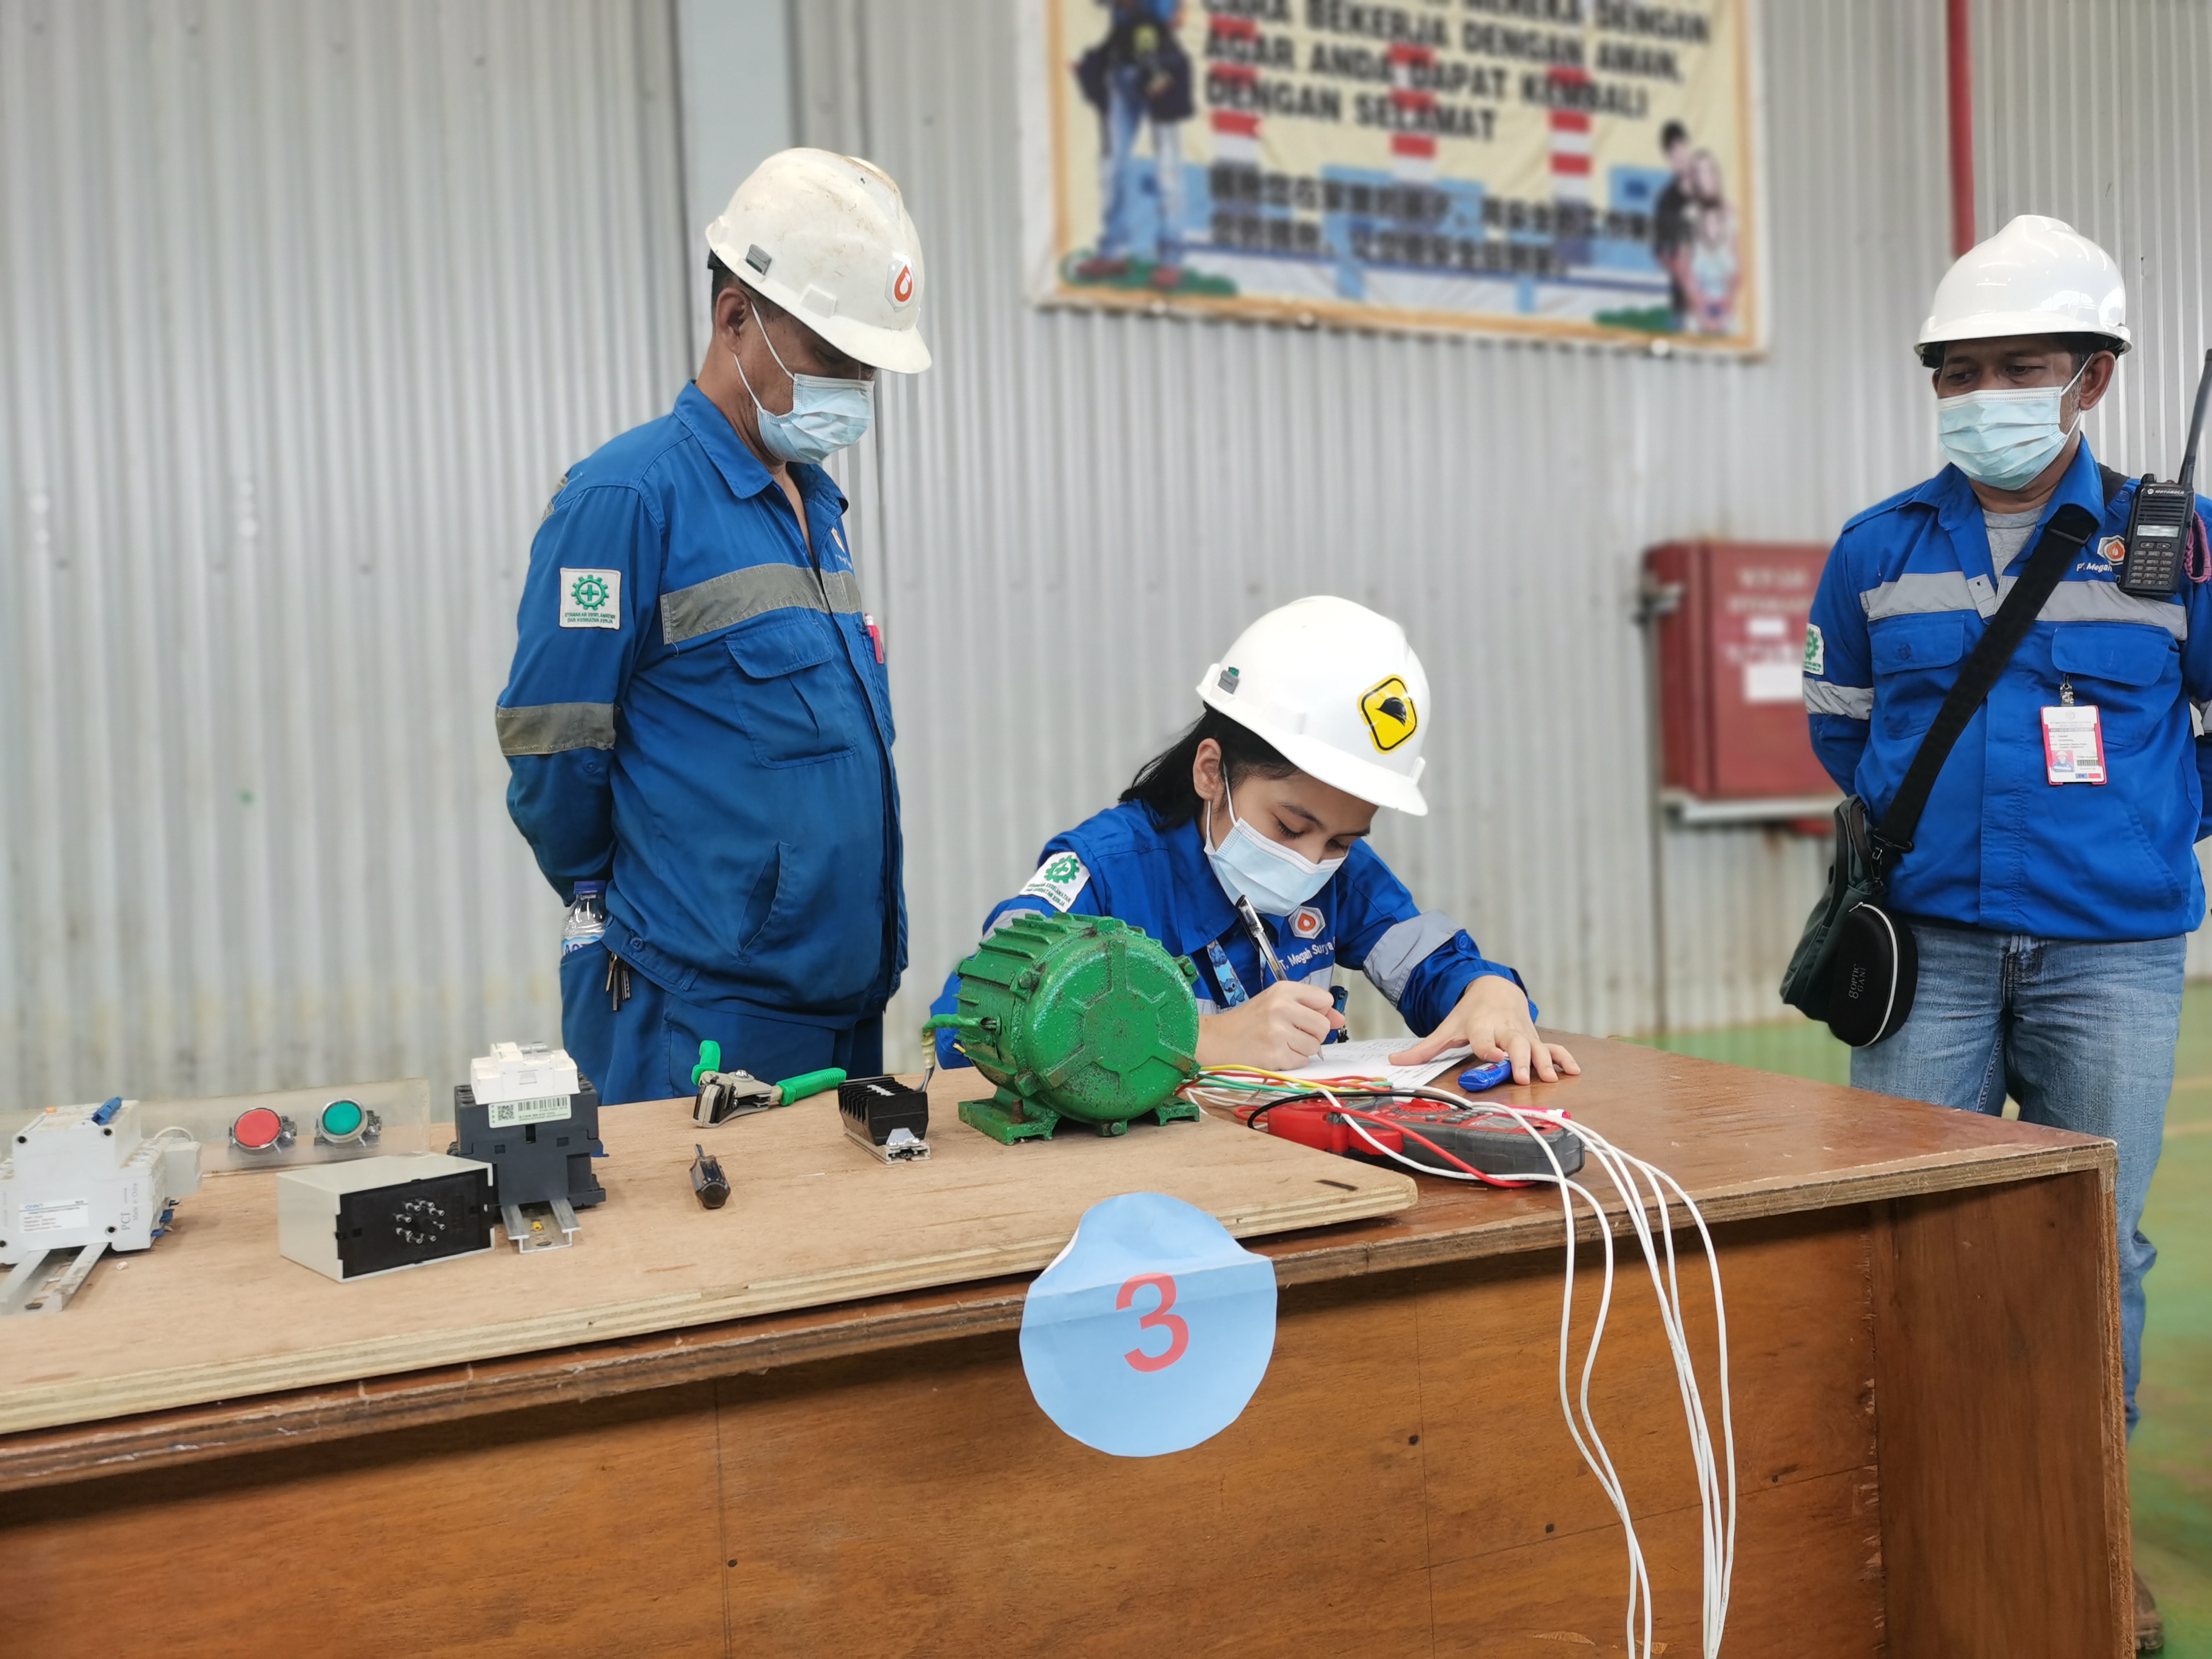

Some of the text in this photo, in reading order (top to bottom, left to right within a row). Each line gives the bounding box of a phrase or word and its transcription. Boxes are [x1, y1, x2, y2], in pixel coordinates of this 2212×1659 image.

[1307, 0, 1449, 46] BEKERJA
[1463, 21, 1586, 65] DENGAN
[1595, 0, 1711, 43] DENGAN
[1206, 27, 1649, 118] AGAR ANDA DAPAT KEMBALI
[1206, 68, 1495, 143] DENGAN SELAMAT
[1287, 947, 1313, 967] Megah
[1311, 941, 1334, 955] Surya
[1115, 1272, 1190, 1373] 3
